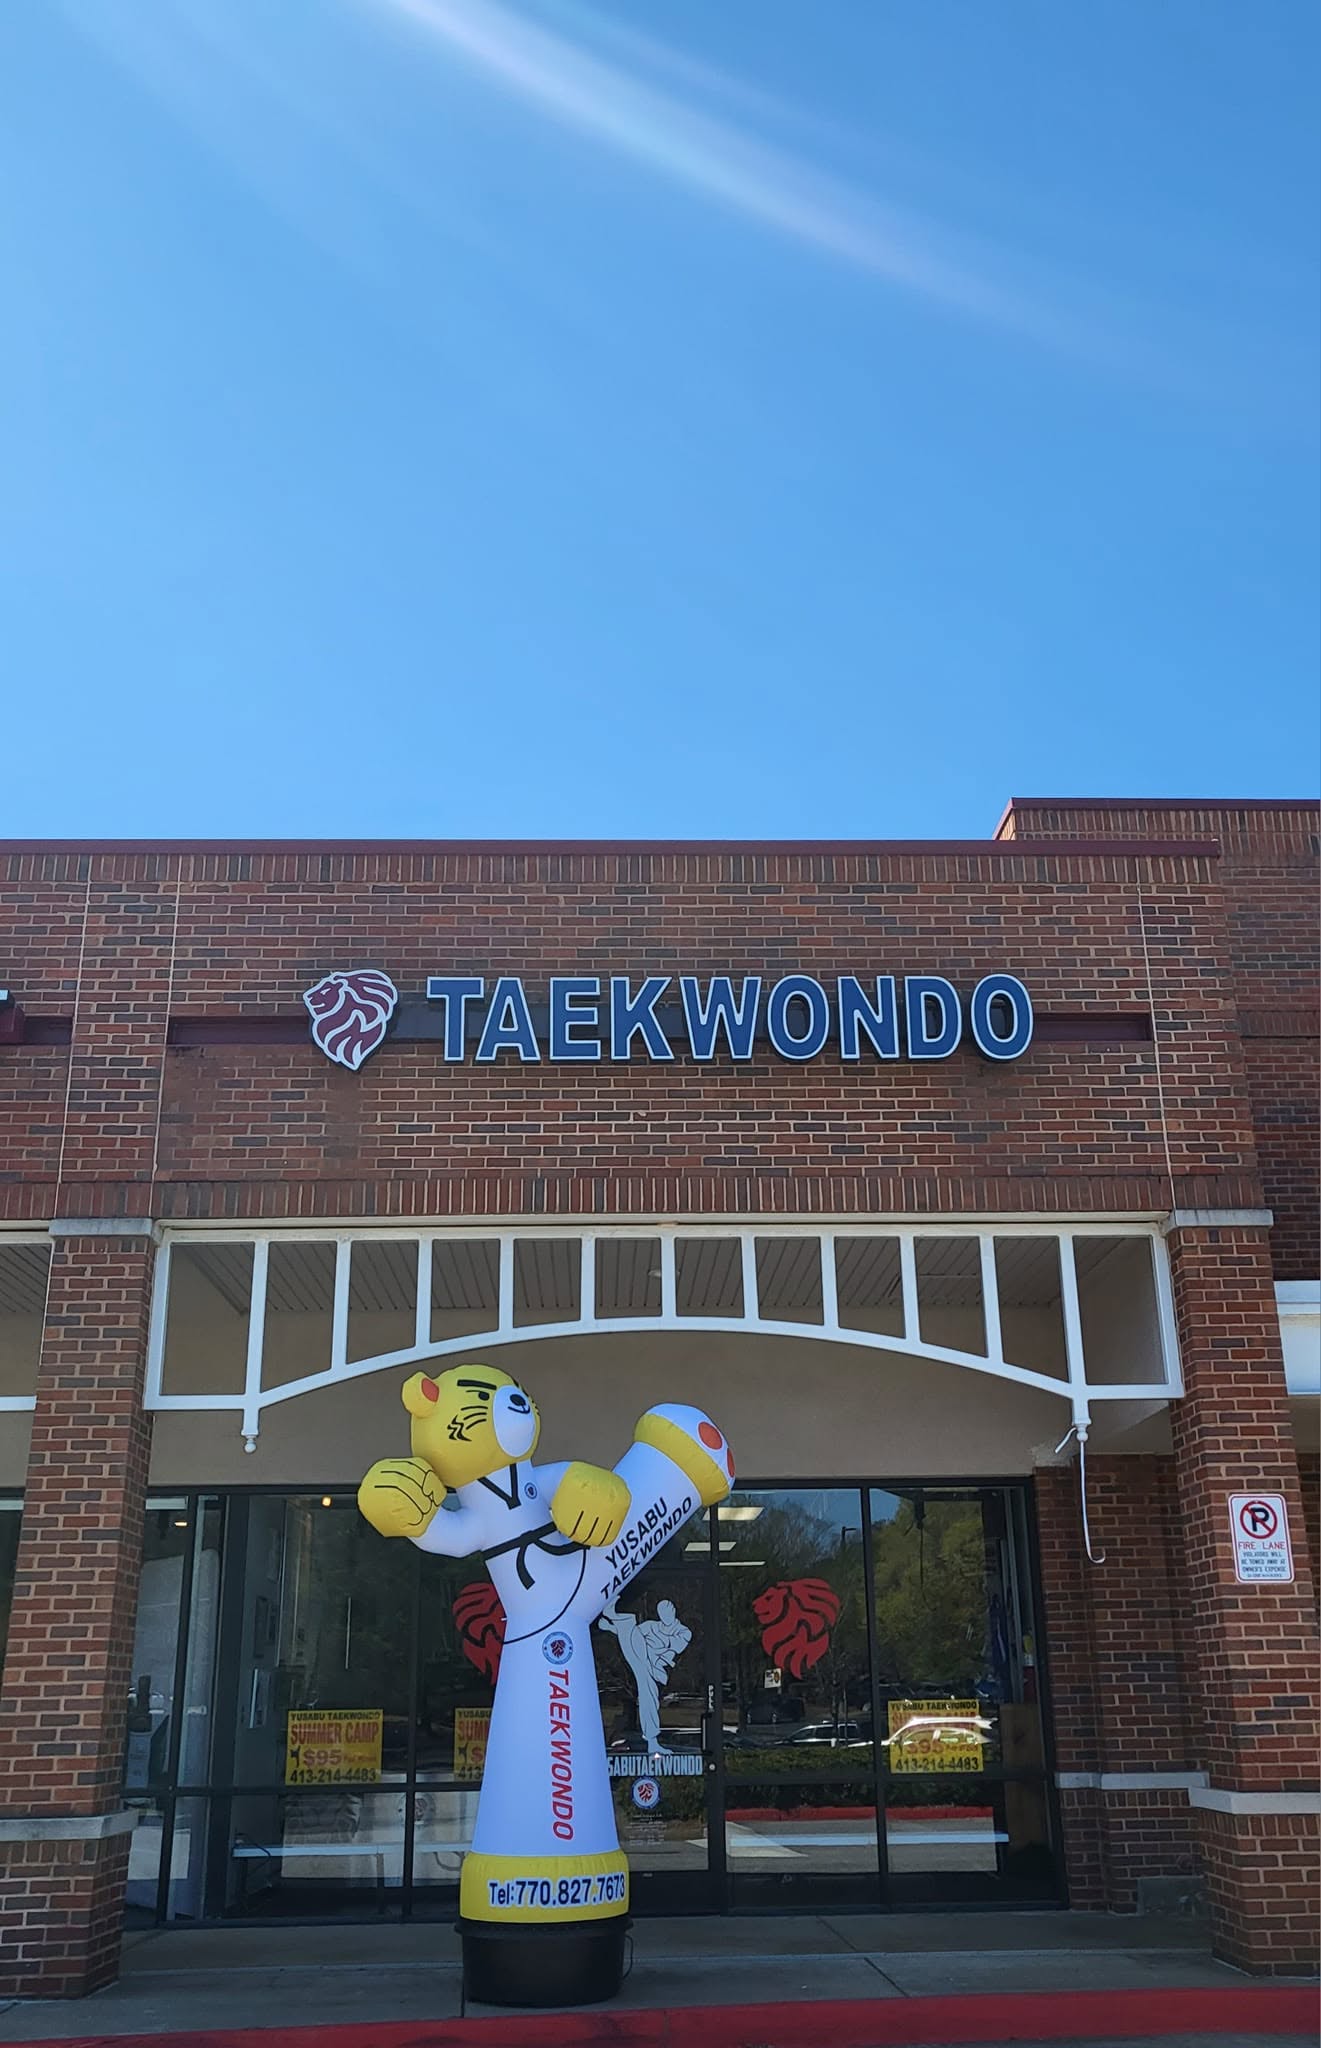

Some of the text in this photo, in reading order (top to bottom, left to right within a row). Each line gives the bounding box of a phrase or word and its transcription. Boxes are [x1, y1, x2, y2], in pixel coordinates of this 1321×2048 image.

[426, 973, 1034, 1062] TAEKWONDO
[605, 1497, 667, 1569] YUSABU
[600, 1496, 692, 1600] TAEKWONDO
[1238, 1541, 1286, 1550] FIRE LANE
[891, 1701, 977, 1711] YUSABU TAEKWONDO
[290, 1711, 380, 1721] YUSABU TAEKWONDO
[290, 1722, 379, 1745] SUMMER CAMP
[303, 1748, 342, 1767] $95
[548, 1669, 575, 1841] TAEKWONDO
[895, 1757, 979, 1770] 413-214-4483
[290, 1768, 377, 1783] 413-214-4483
